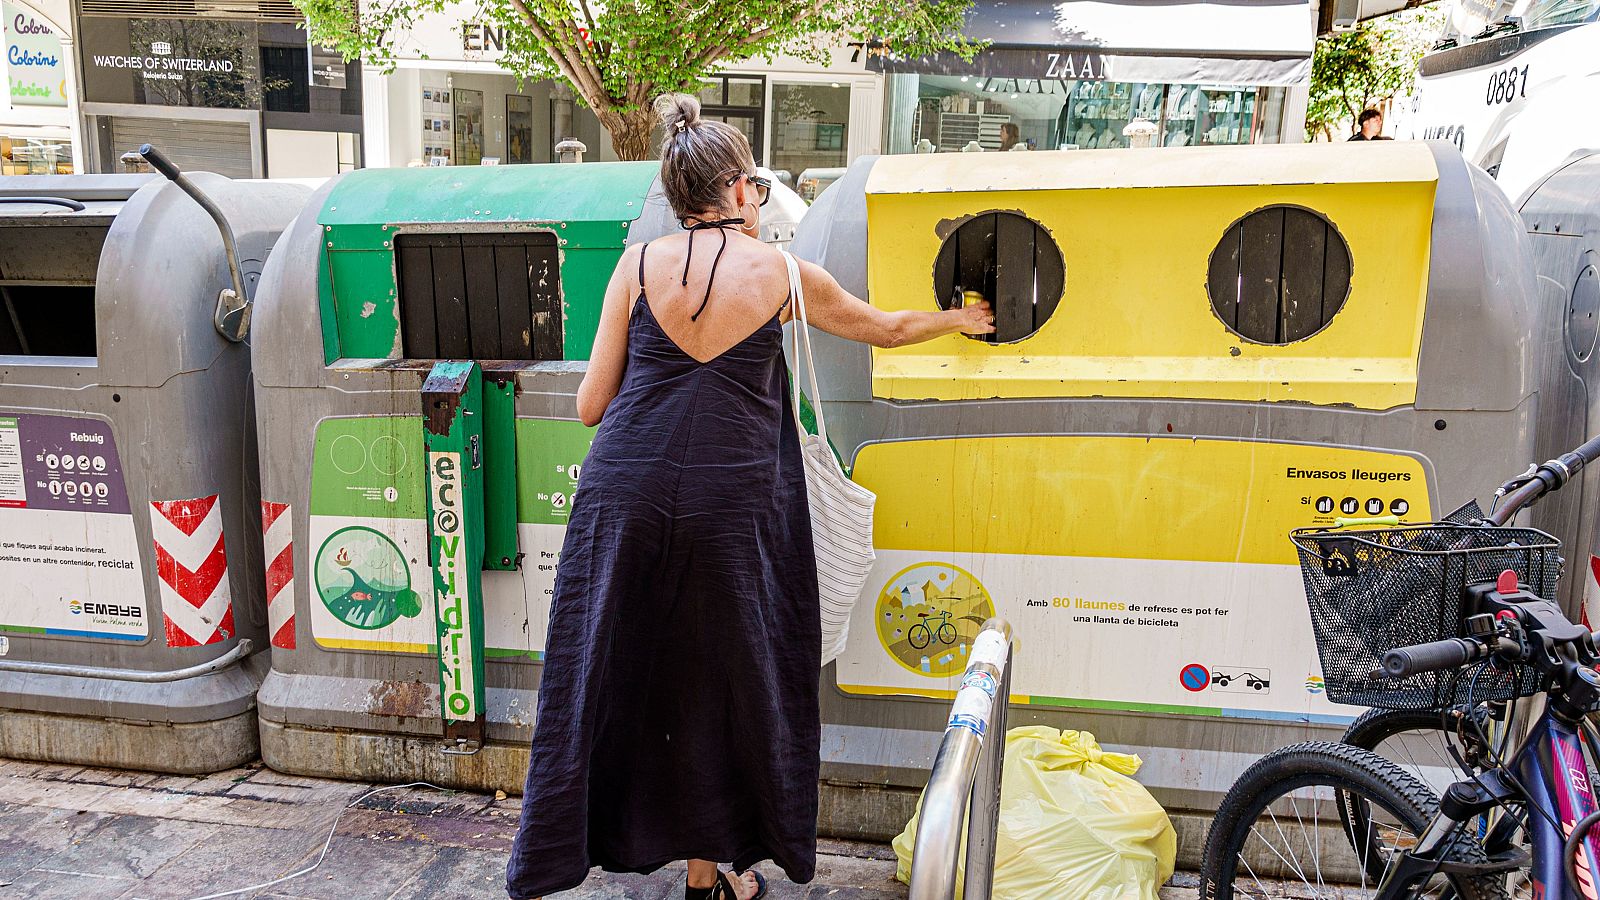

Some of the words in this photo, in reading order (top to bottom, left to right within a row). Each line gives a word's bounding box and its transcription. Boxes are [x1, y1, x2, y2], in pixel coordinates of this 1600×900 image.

[8, 45, 58, 67] Colorins
[847, 42, 865, 62] 7
[94, 55, 143, 69] WATCHES
[145, 57, 160, 70] OF
[162, 58, 234, 73] SWITZERLAND
[1045, 53, 1116, 79] ZAAN
[9, 75, 51, 97] olorins
[1486, 64, 1529, 106] 0881
[70, 432, 104, 445] Rebuig
[1286, 467, 1347, 480] Envasos
[1351, 469, 1412, 483] lleugers
[37, 480, 47, 488] No
[537, 493, 549, 501] No
[17, 542, 36, 550] fiques
[97, 559, 134, 569] reciclat
[1026, 599, 1049, 608] Amb
[1052, 597, 1071, 608] 80
[1075, 597, 1126, 611] llaunes
[1128, 603, 1141, 612] de
[1143, 604, 1178, 614] refresc
[1195, 607, 1212, 617] pot
[1214, 607, 1229, 616] fer
[1073, 615, 1091, 623] una
[1093, 615, 1121, 625] llanta
[1122, 617, 1135, 626] de
[1137, 617, 1179, 628] bicicleta
